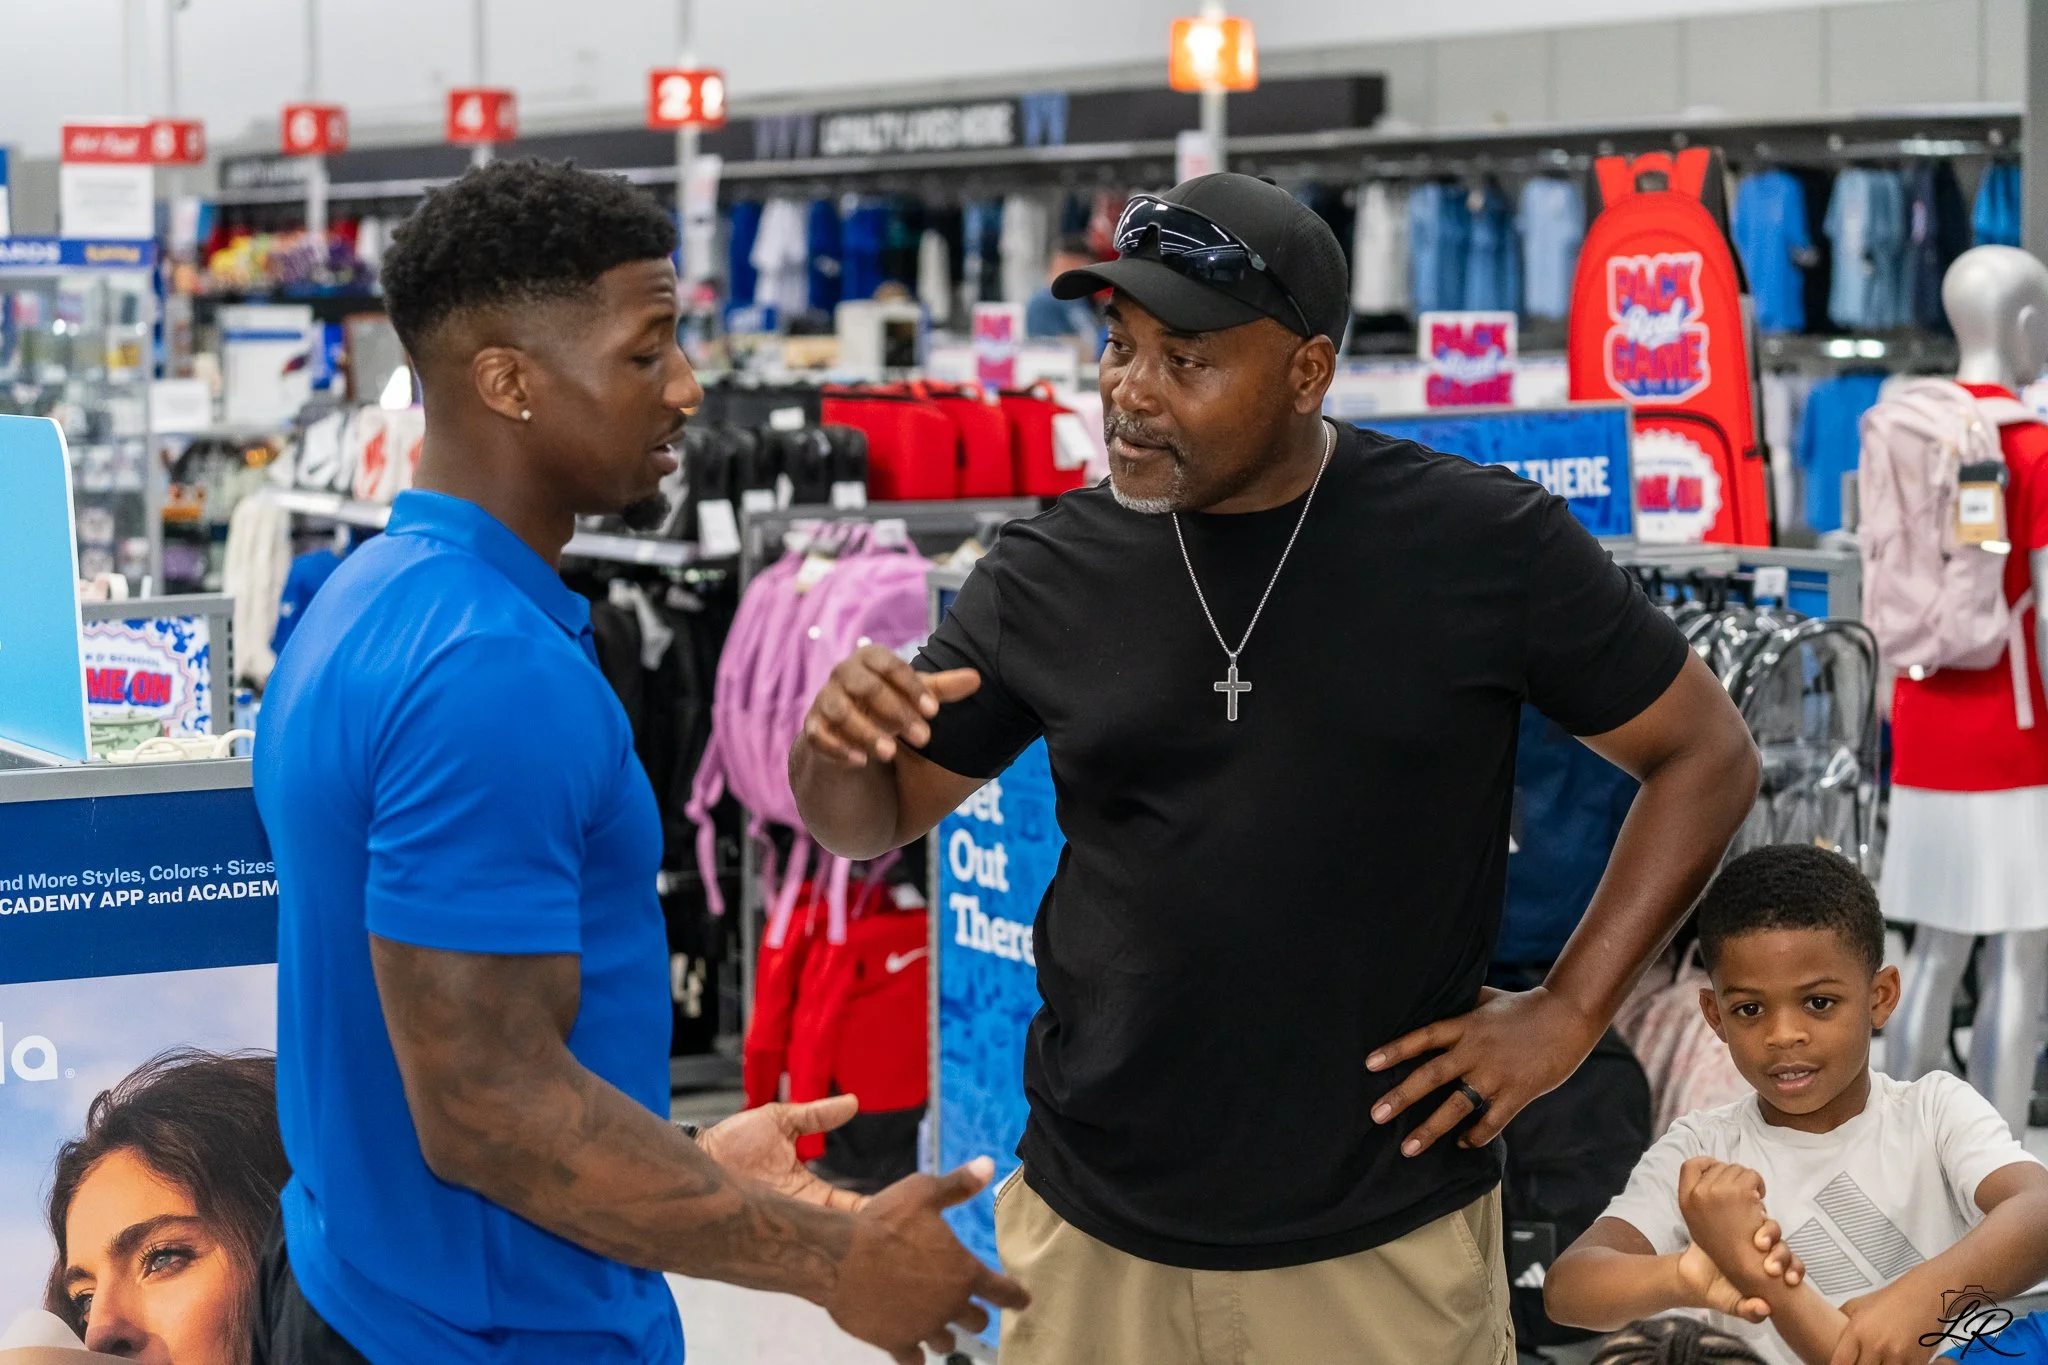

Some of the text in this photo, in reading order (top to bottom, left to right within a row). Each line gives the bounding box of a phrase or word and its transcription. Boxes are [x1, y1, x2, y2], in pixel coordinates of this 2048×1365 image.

[1523, 455, 1612, 499] THERE
[130, 670, 172, 707] ON
[955, 777, 1004, 825] et
[28, 873, 78, 890] More
[82, 867, 146, 888] Styles,
[149, 864, 209, 881] Colors
[212, 863, 223, 875] +
[227, 859, 276, 876] Sizes
[949, 828, 1009, 892] Out
[0, 879, 279, 915] CADEMY APP and ACADEM
[949, 892, 1036, 966] There
